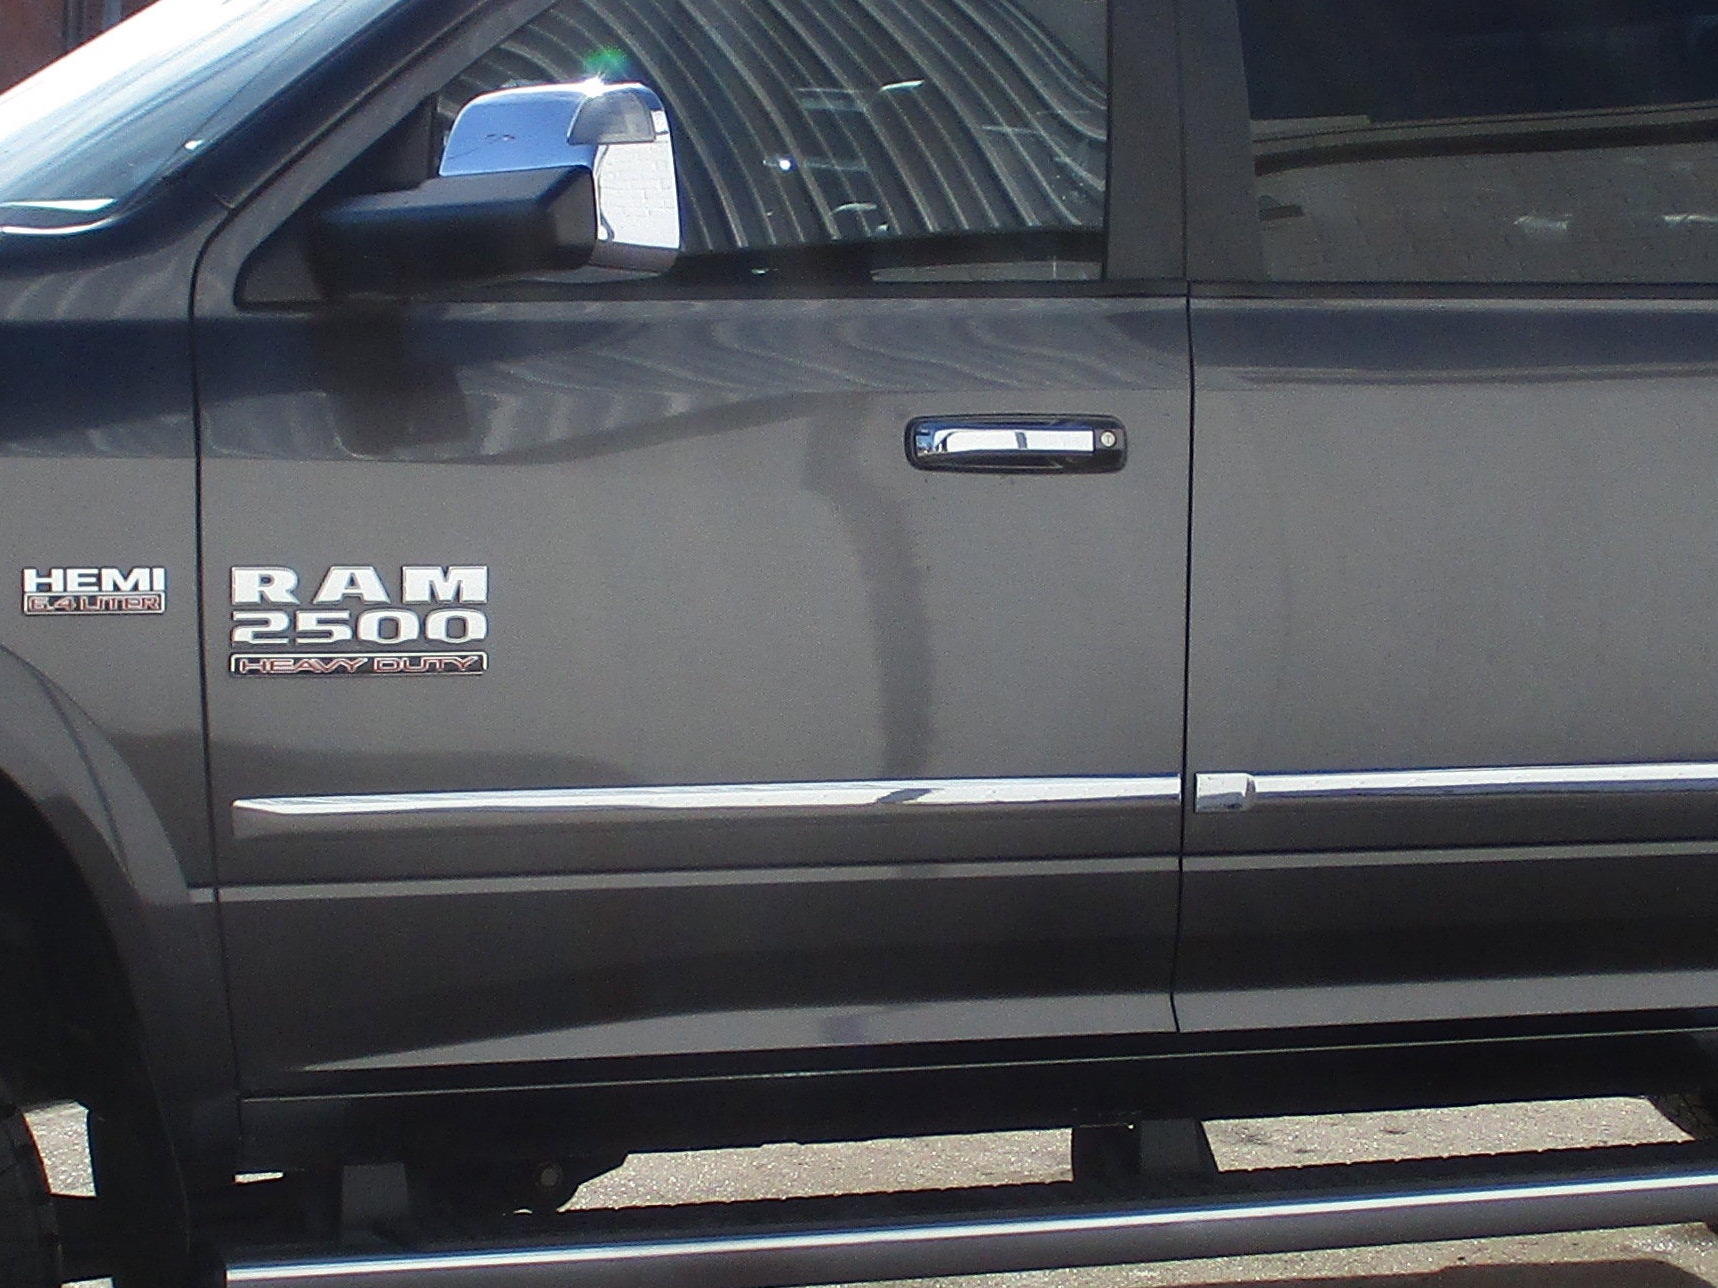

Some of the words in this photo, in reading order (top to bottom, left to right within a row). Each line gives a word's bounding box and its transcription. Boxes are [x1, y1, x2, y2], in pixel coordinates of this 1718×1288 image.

[23, 567, 165, 592] HEMI
[230, 565, 488, 605] RAM
[28, 596, 76, 611] 6.4
[80, 595, 160, 611] LITER
[231, 608, 488, 644] 2500
[239, 657, 368, 674] HEAVY
[373, 655, 479, 673] DUTY
